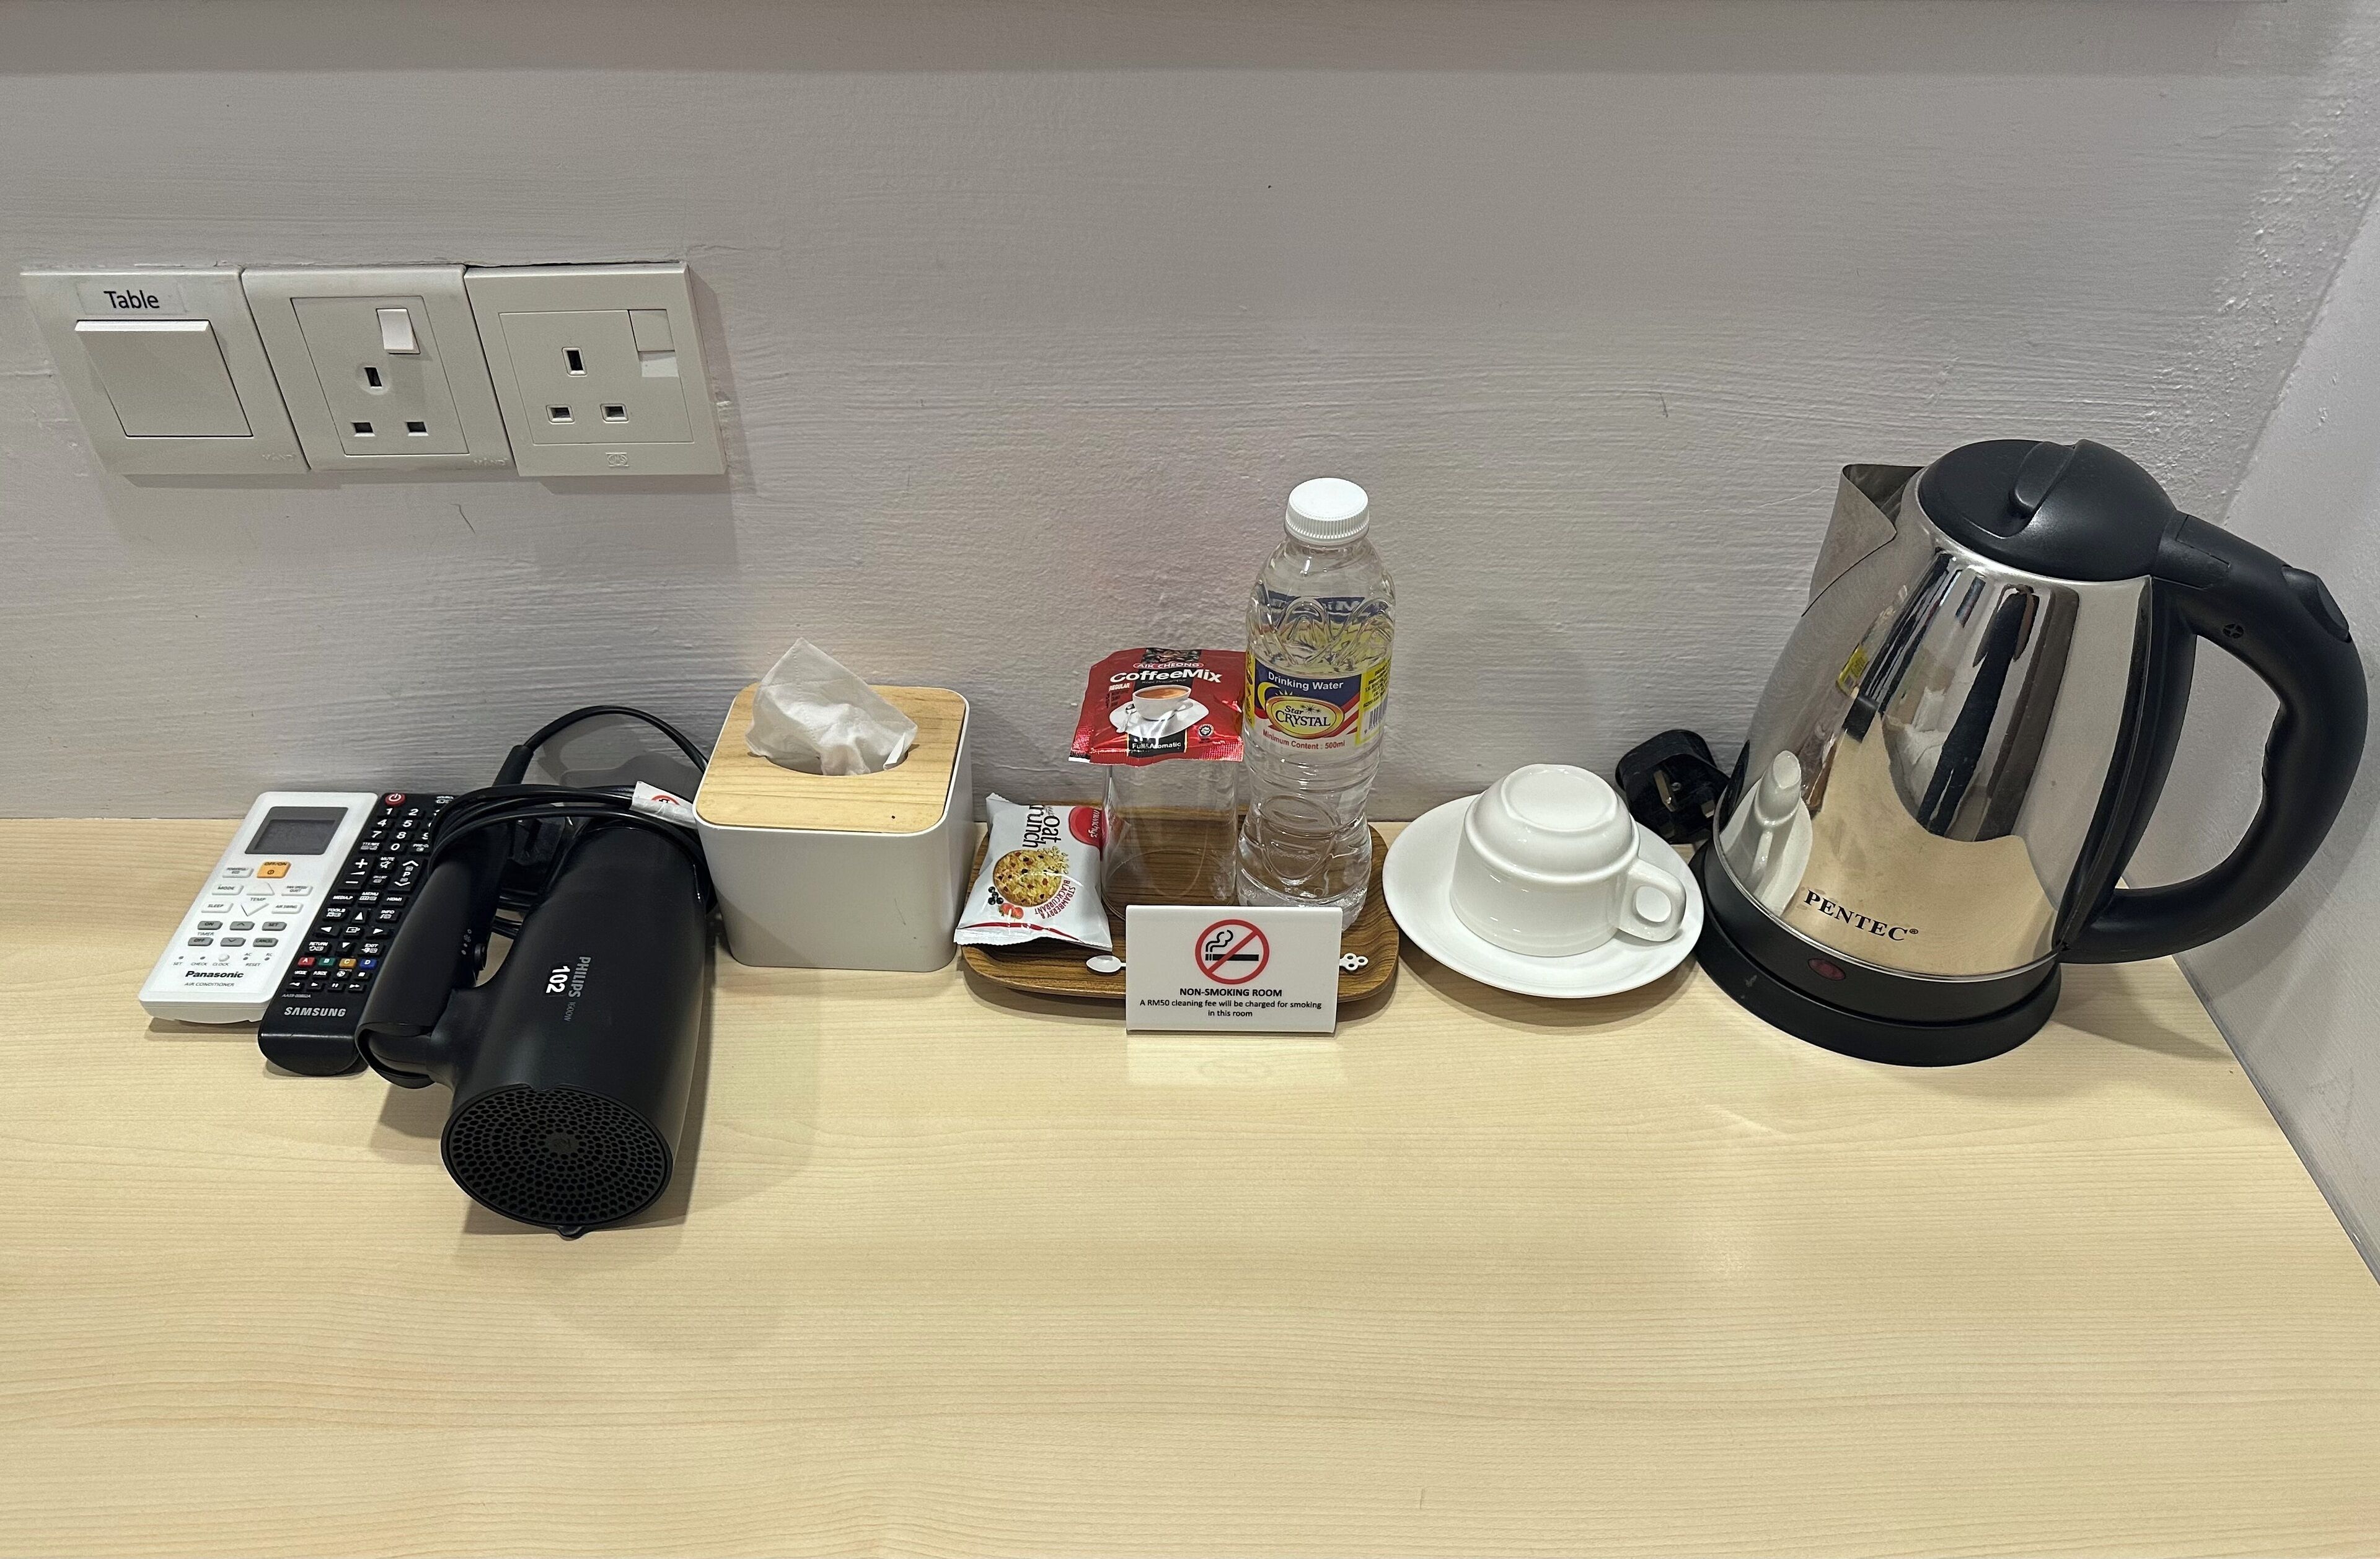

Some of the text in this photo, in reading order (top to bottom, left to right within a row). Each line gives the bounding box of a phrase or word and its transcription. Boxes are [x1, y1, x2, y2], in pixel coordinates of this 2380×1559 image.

[104, 289, 160, 309] Table
[1110, 669, 1223, 683] CoffeeMix
[1268, 672, 1344, 692] Drinking Water
[1285, 705, 1304, 715] Star
[1275, 709, 1331, 727] CRYSTAL
[1263, 729, 1290, 746] Minimum
[1291, 740, 1319, 750] Content
[1325, 740, 1346, 749] 500ml
[408, 808, 419, 816] 2
[377, 819, 387, 827] 4
[403, 820, 413, 828] 5
[1022, 804, 1044, 848] runch
[1041, 815, 1062, 845] Oat
[371, 830, 382, 838] 7
[396, 832, 407, 840] 8
[390, 843, 400, 851] 0
[1034, 879, 1071, 914] BLACKCURRANT
[1047, 886, 1076, 918] STRAWBERRY
[545, 965, 571, 993] 102
[568, 956, 591, 998] PHILIPS
[1179, 988, 1282, 997] NON-SMOKING ROOM
[1171, 999, 1203, 1008] cleaning
[1245, 1001, 1275, 1009] charged
[1290, 1001, 1322, 1009] smoking
[284, 1007, 346, 1017] SAMSUNG
